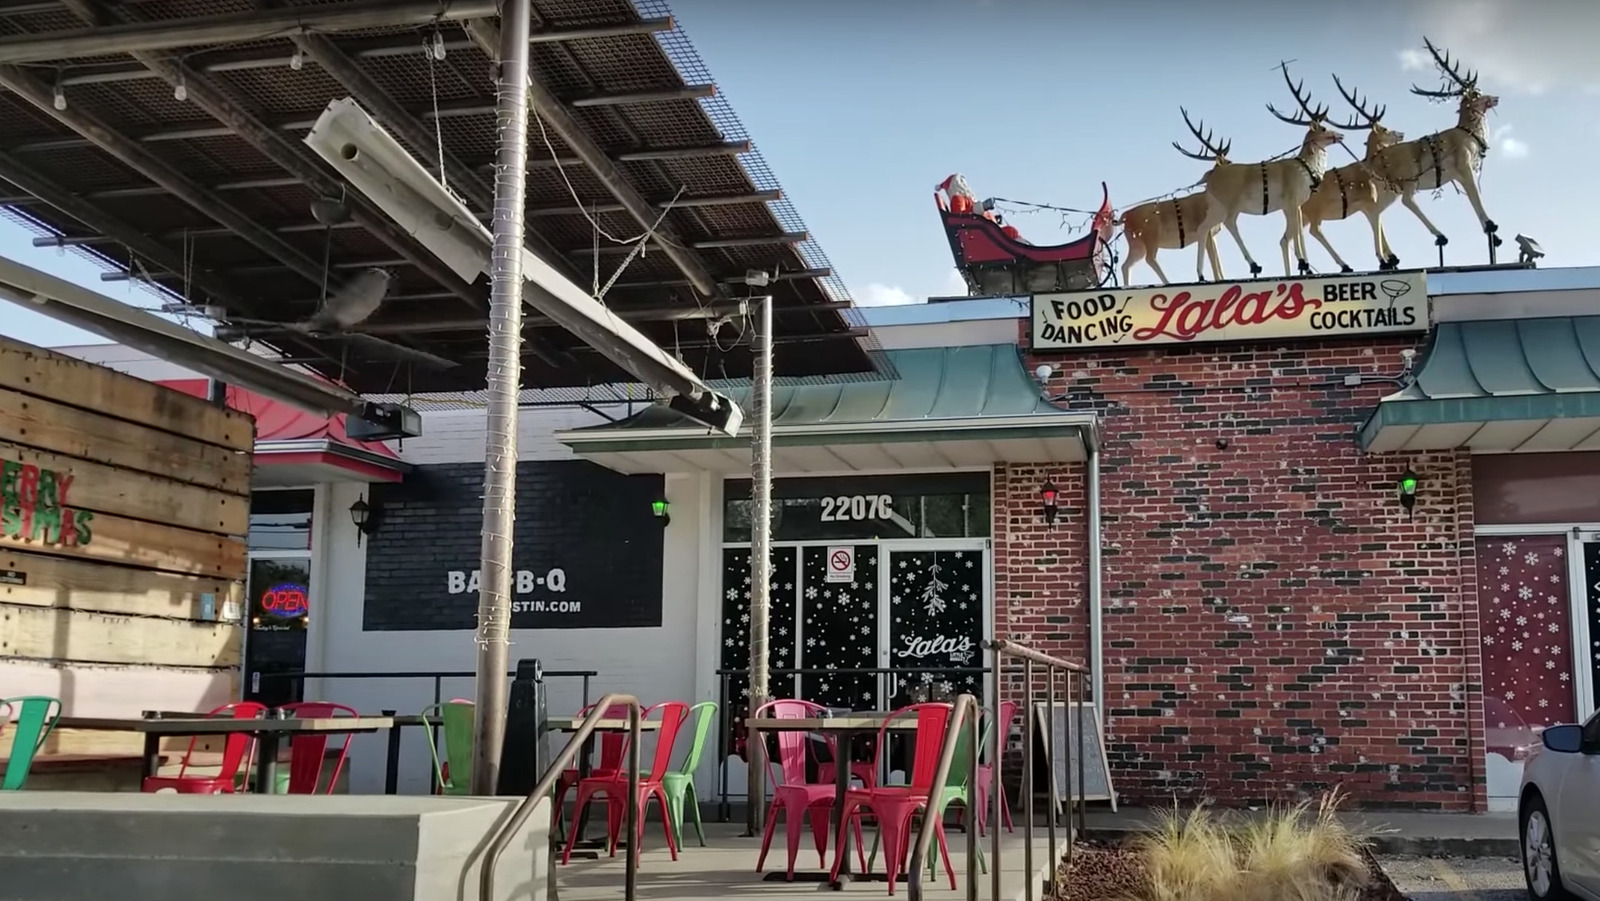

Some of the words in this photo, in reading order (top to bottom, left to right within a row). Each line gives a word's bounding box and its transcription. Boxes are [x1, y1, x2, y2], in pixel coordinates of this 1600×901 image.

[1323, 282, 1377, 302] BEER
[1051, 294, 1116, 320] FOOD
[1133, 282, 1322, 341] Lala's
[1310, 306, 1416, 330] COCKTAILS
[1040, 315, 1134, 344] DANCING
[0, 458, 75, 507] ERRY
[0, 500, 94, 546] STMAS
[262, 591, 308, 610] OPEN
[512, 601, 581, 612] STIN.COM
[898, 635, 976, 658] Lala's
